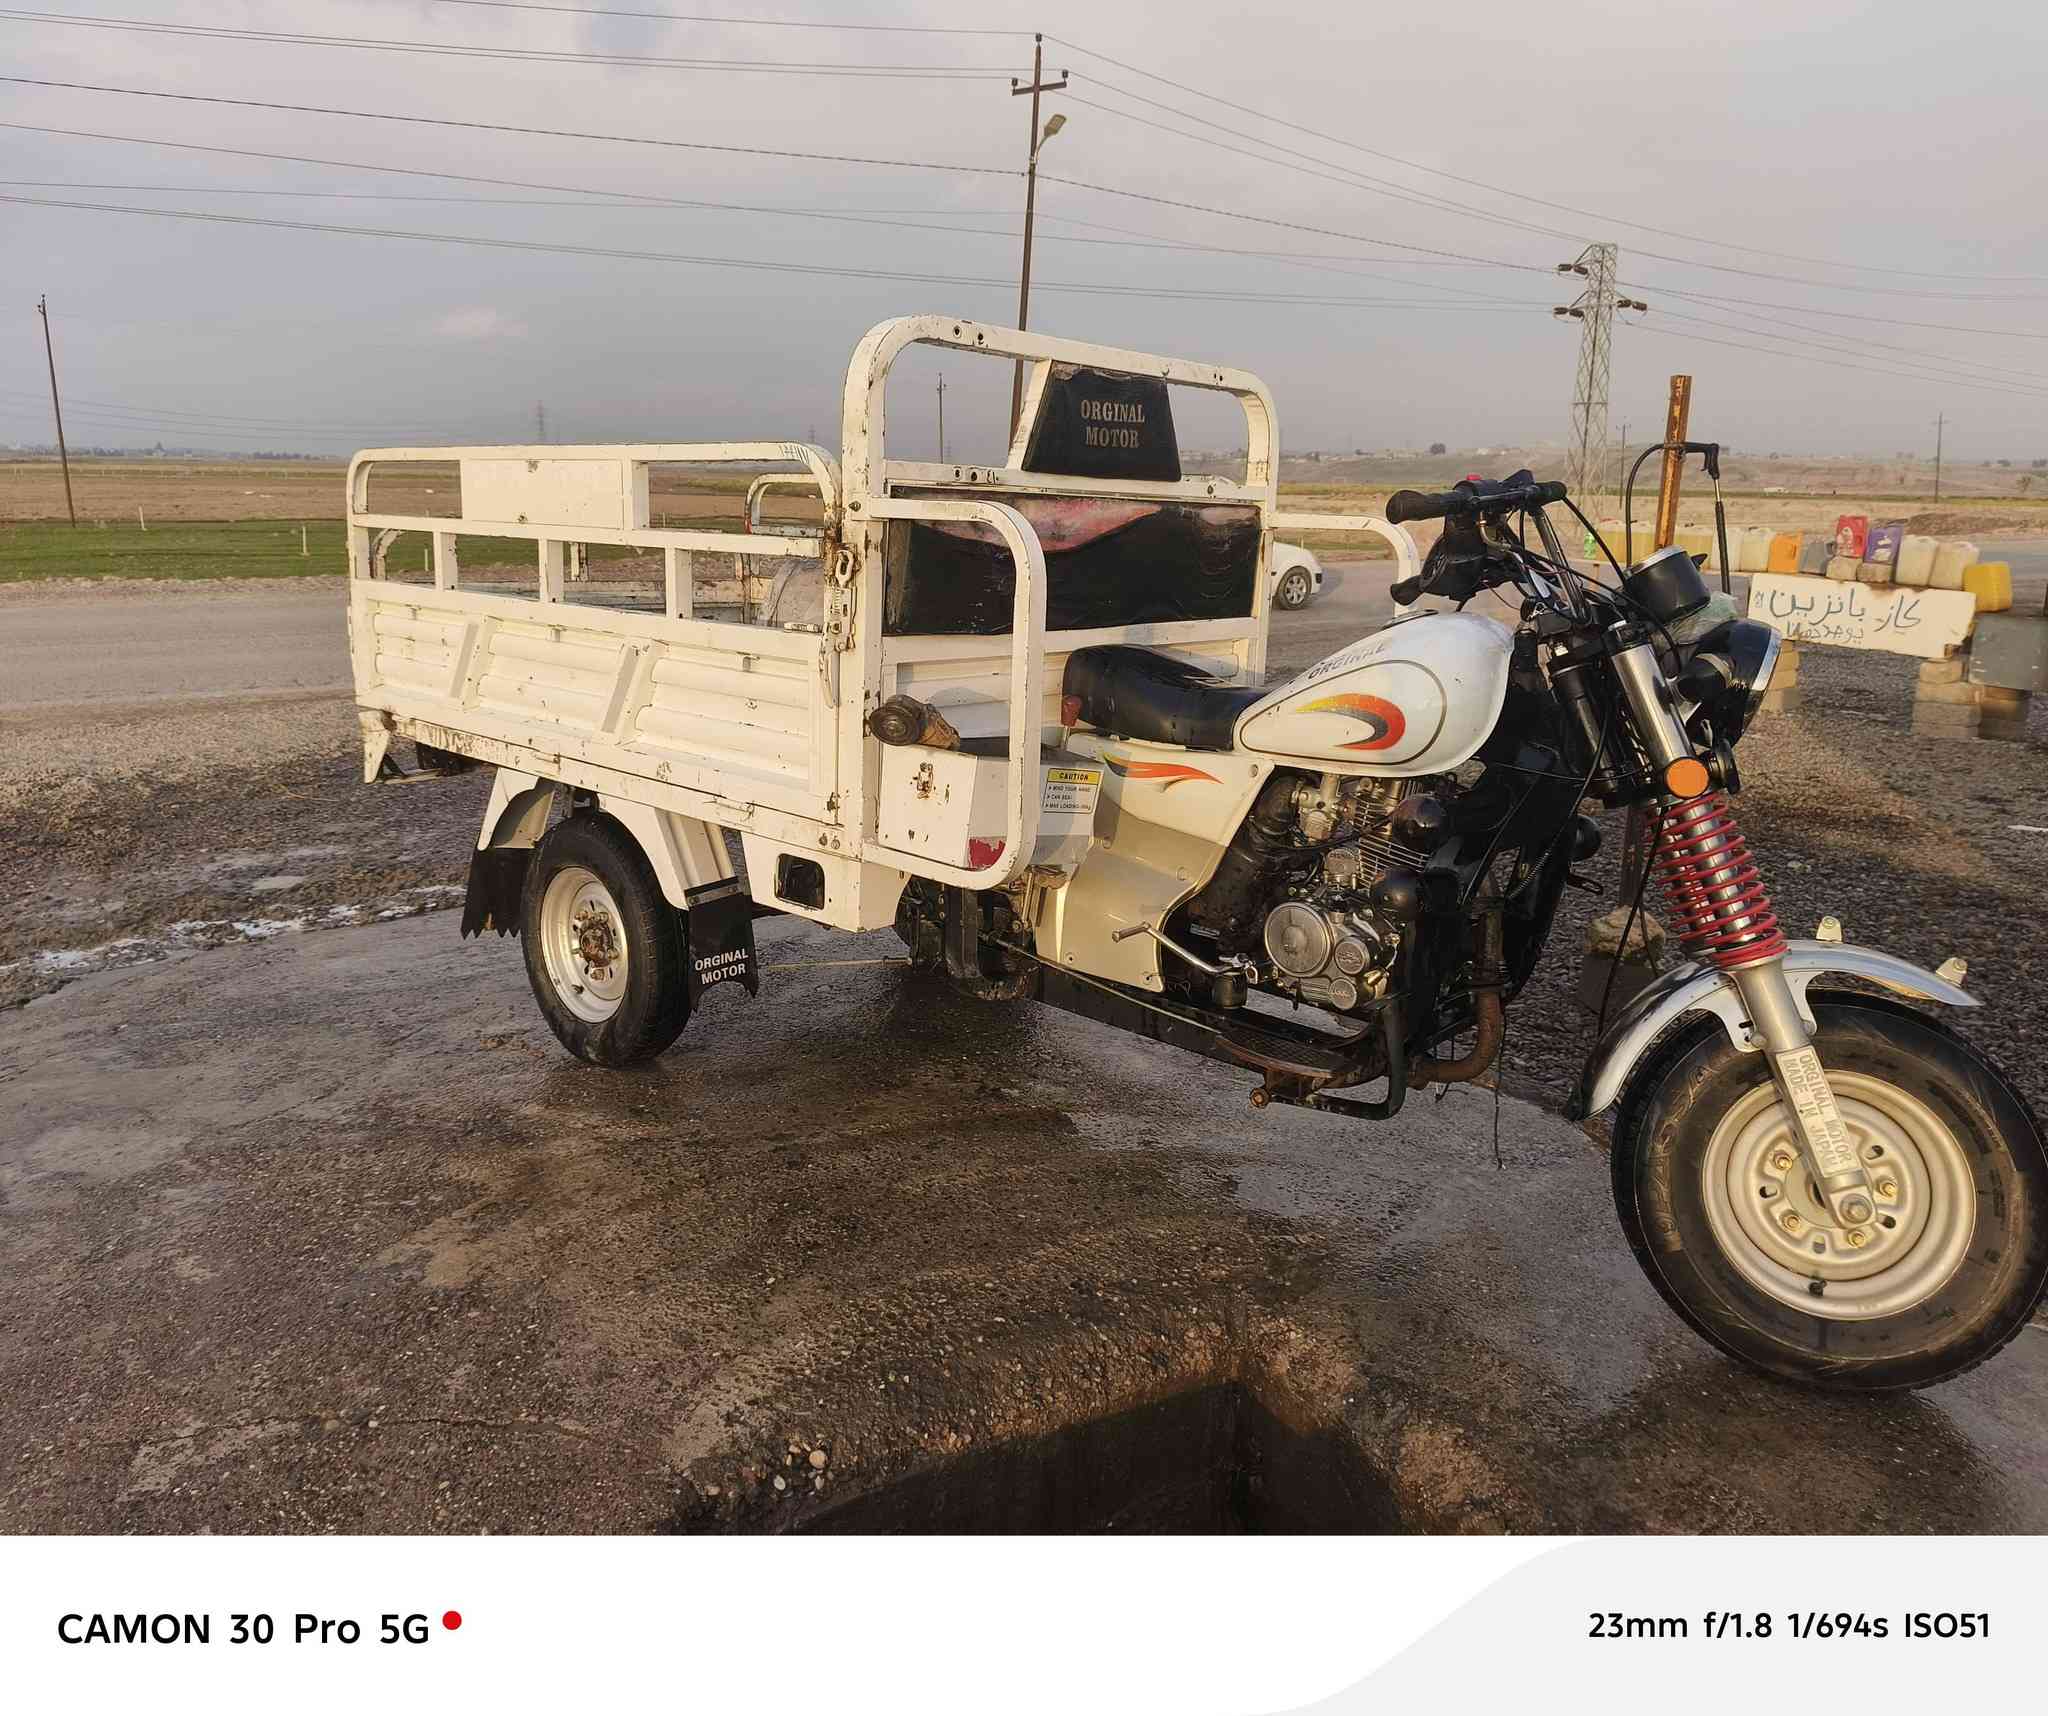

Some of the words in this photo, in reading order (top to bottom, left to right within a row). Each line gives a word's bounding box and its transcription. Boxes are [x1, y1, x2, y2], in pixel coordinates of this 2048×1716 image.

[1081, 399, 1145, 423] ORGINAL
[1086, 427, 1139, 448] MOTOR
[1059, 772, 1089, 781] CAUTION
[694, 948, 749, 971] ORGINAL
[701, 963, 746, 985] MOTOR
